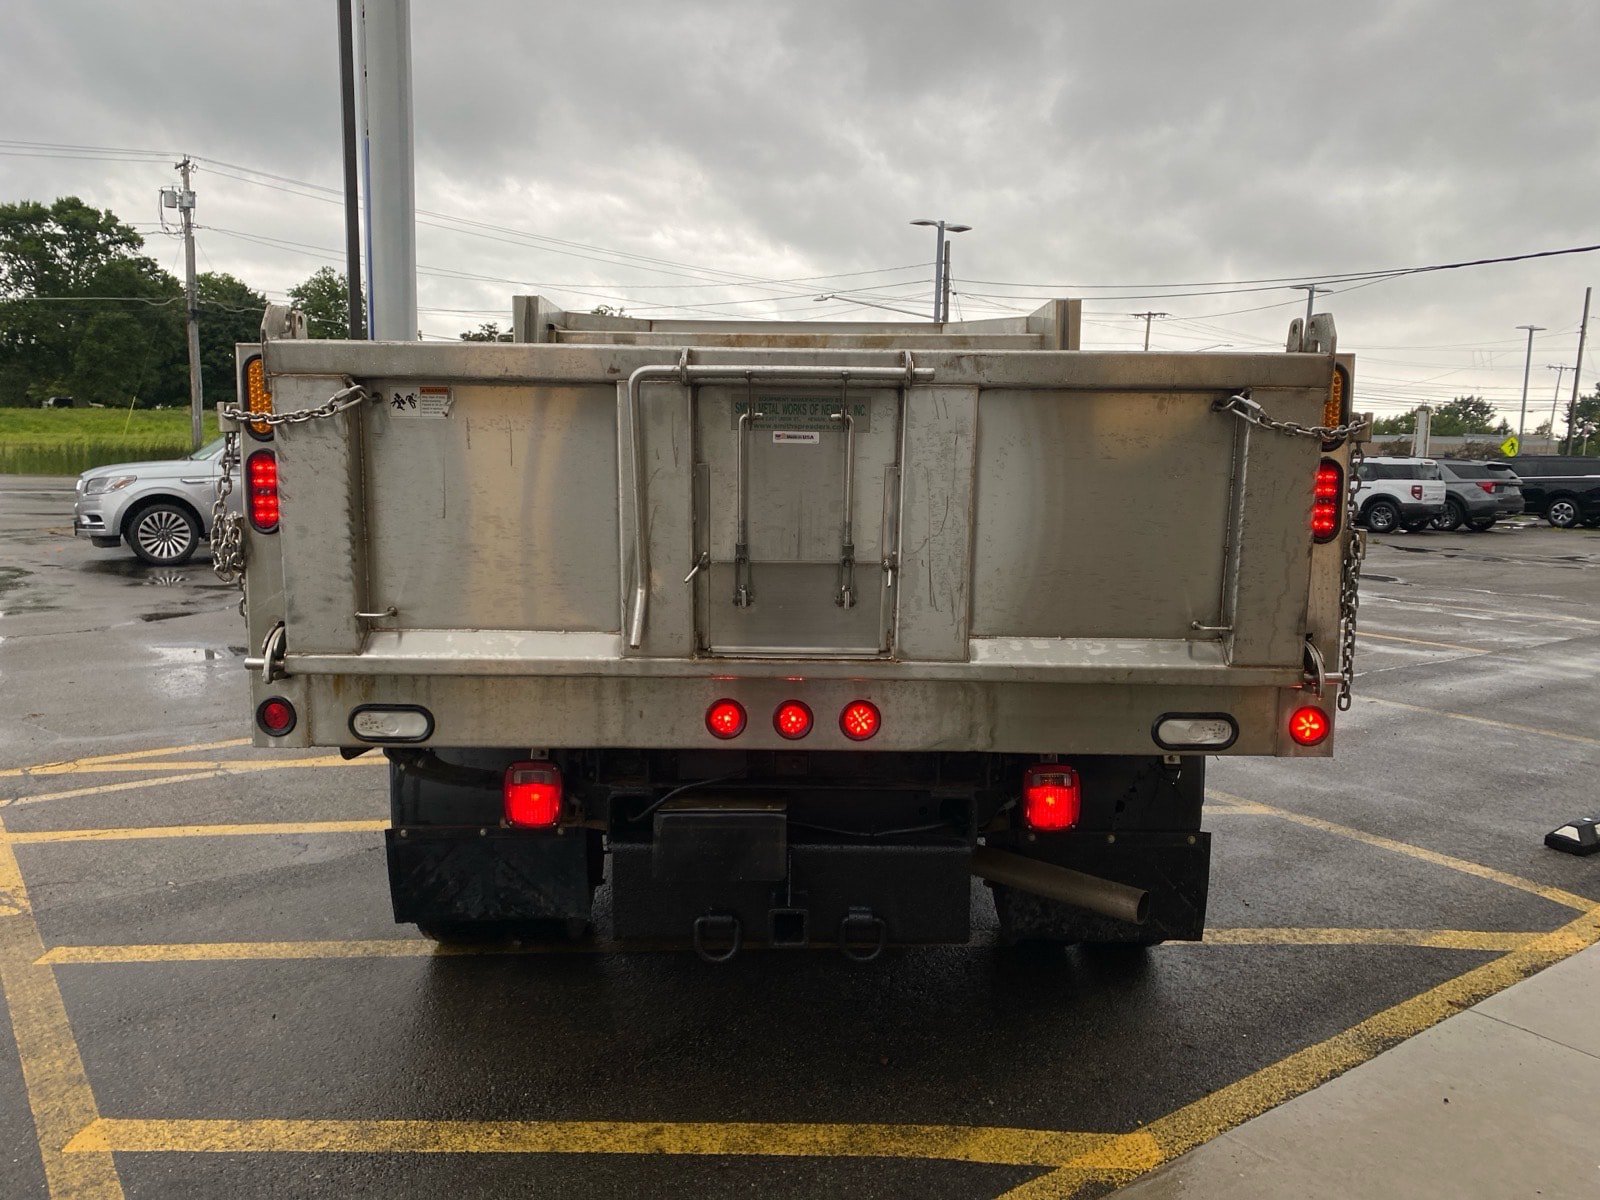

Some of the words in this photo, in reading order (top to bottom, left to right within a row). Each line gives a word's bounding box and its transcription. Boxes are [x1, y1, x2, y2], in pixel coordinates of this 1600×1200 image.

[758, 403, 779, 414] METAL
[782, 403, 807, 415] WORKS
[810, 404, 819, 415] OF
[854, 404, 866, 416] INC.
